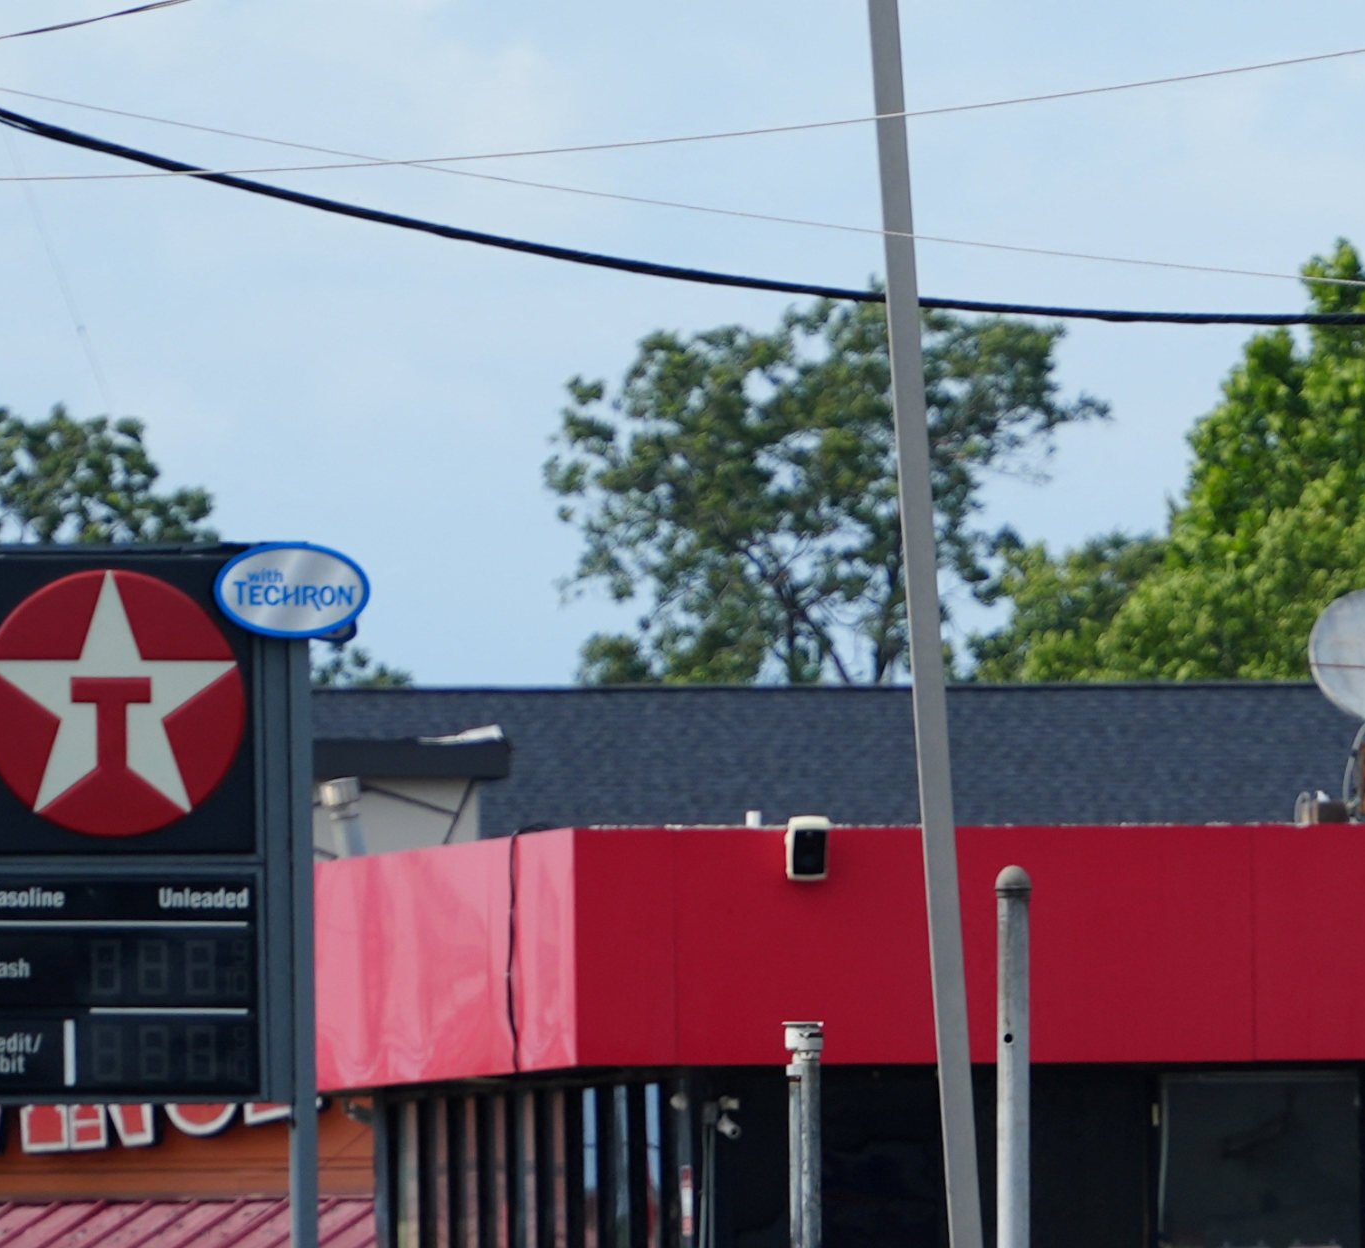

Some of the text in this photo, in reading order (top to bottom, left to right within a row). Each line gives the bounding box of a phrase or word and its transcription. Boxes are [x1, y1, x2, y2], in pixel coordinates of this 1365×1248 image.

[247, 568, 283, 582] with
[233, 581, 356, 612] TECHRON
[159, 887, 250, 909] Unleaded
